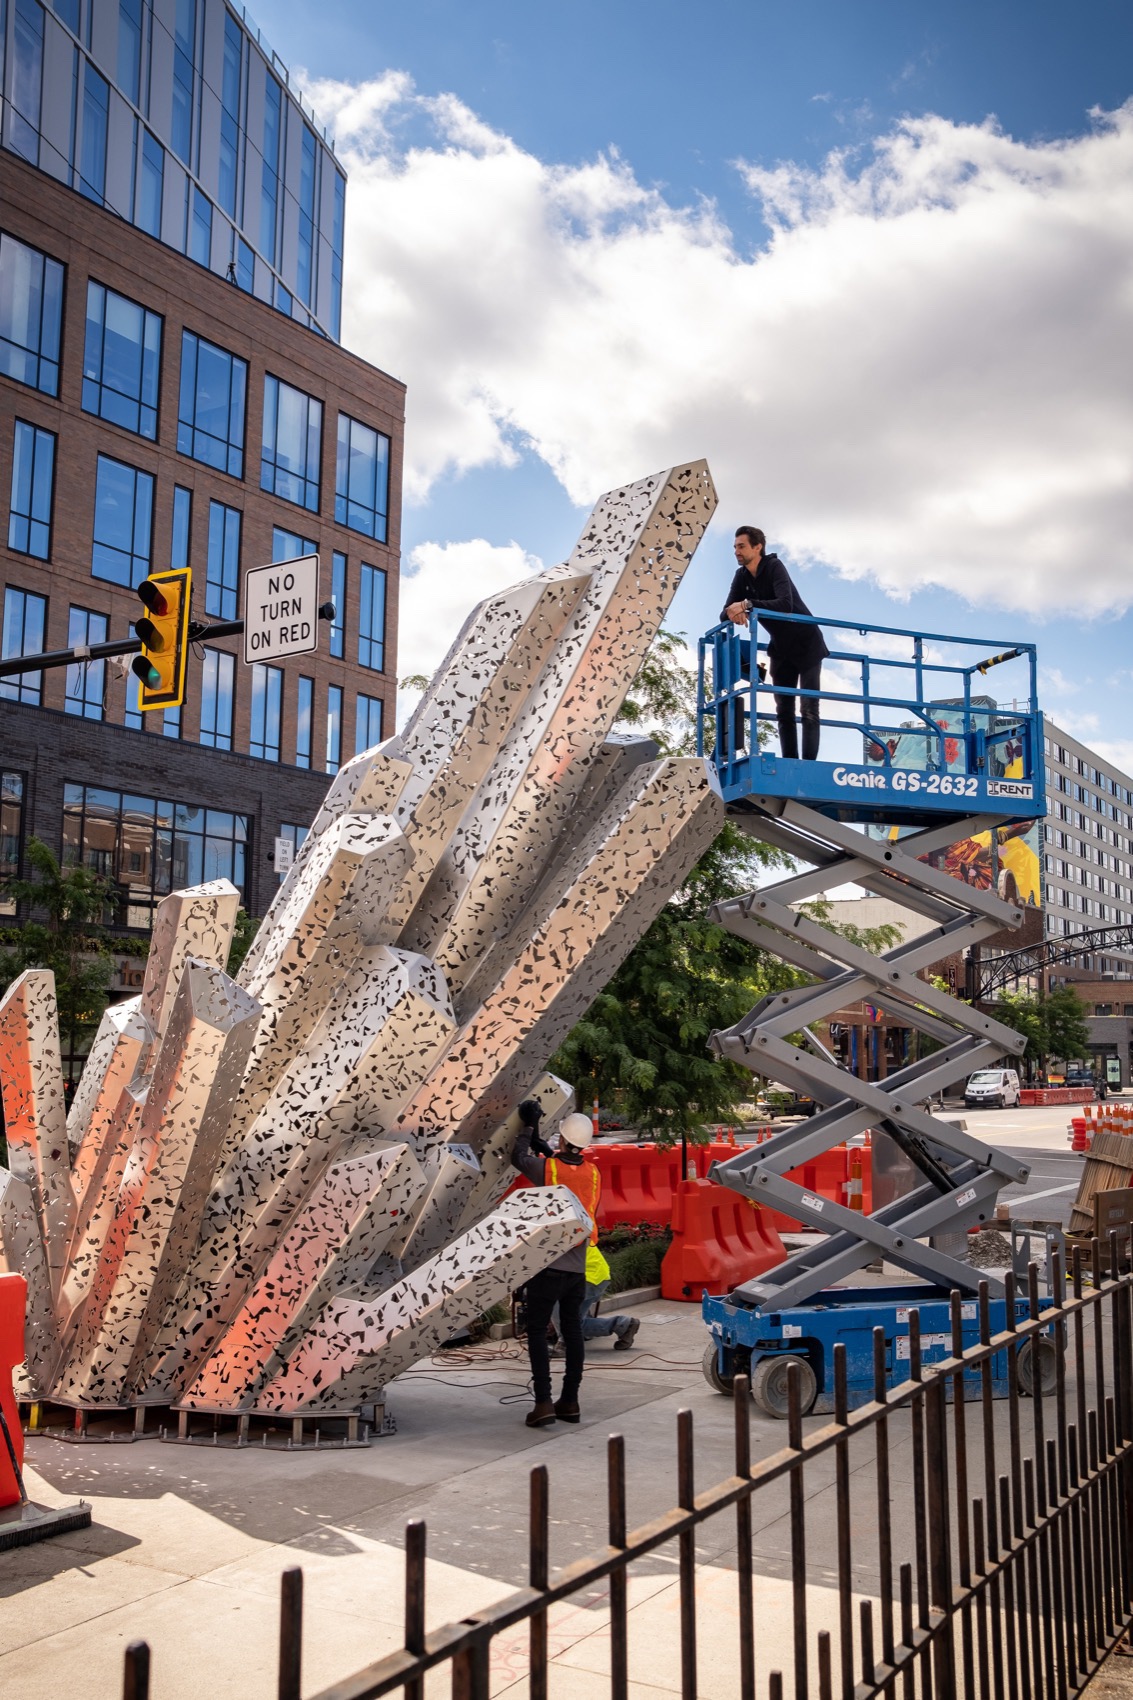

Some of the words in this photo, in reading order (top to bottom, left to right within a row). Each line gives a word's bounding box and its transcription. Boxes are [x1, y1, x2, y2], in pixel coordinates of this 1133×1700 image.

[268, 573, 295, 595] NO
[260, 597, 302, 622] TURN
[251, 630, 271, 650] ON
[280, 622, 311, 644] RED
[832, 767, 886, 789] Genie
[891, 771, 979, 797] GS-2632
